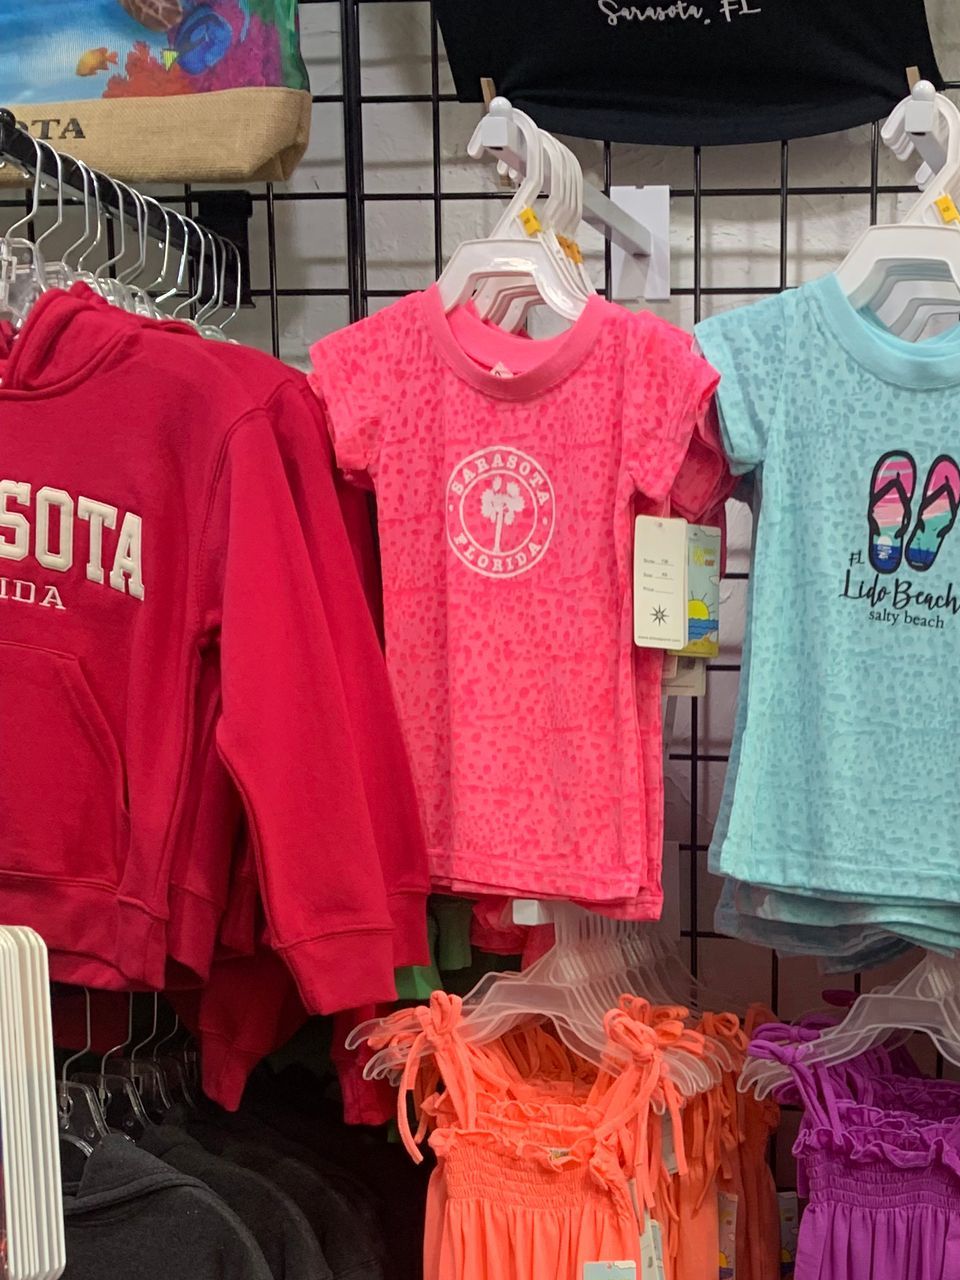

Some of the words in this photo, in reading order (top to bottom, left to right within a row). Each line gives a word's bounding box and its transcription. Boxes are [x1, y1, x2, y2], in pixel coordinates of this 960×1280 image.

[719, 0, 762, 22] FL
[451, 453, 550, 506] SARASOTA
[0, 479, 145, 601] SOTA
[453, 533, 542, 571] FLORIDA
[839, 569, 891, 608] Lido
[868, 609, 900, 626] salty
[904, 611, 944, 629] beach
